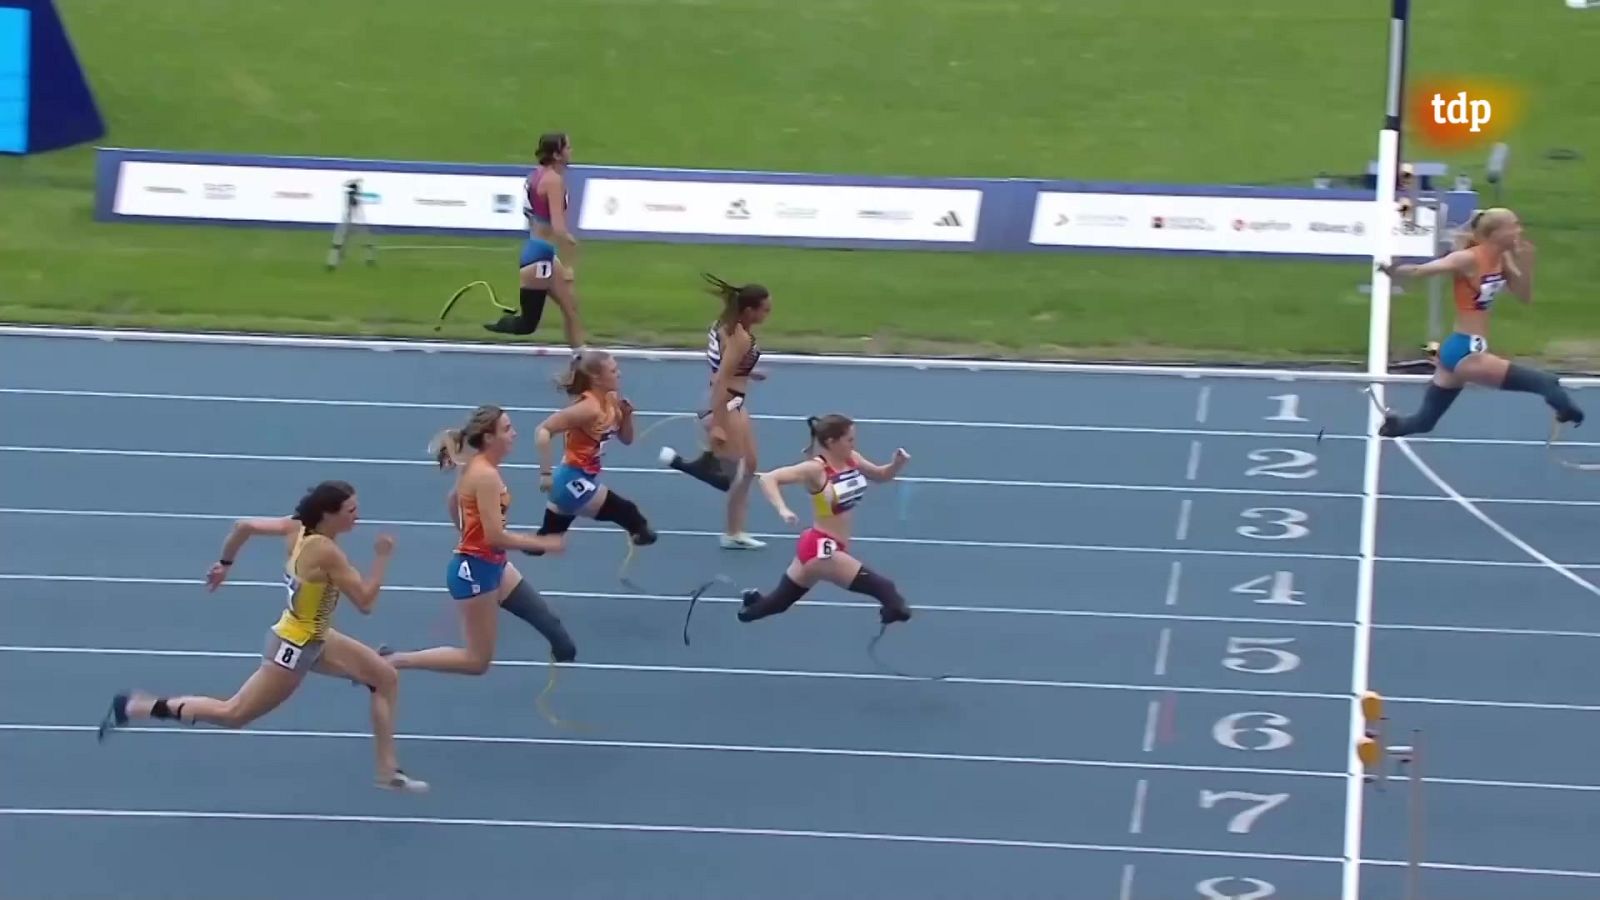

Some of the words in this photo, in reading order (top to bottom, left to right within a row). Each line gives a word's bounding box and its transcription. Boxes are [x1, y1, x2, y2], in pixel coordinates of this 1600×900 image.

[1262, 394, 1311, 422] 1
[1244, 448, 1318, 479] 2
[571, 480, 585, 493] 5
[1235, 507, 1310, 540] 3
[823, 541, 832, 556] 6
[1230, 570, 1307, 606] 4
[281, 647, 295, 664] 8
[1221, 636, 1301, 674] 5
[1212, 711, 1294, 750] 6
[1199, 789, 1290, 834] 7
